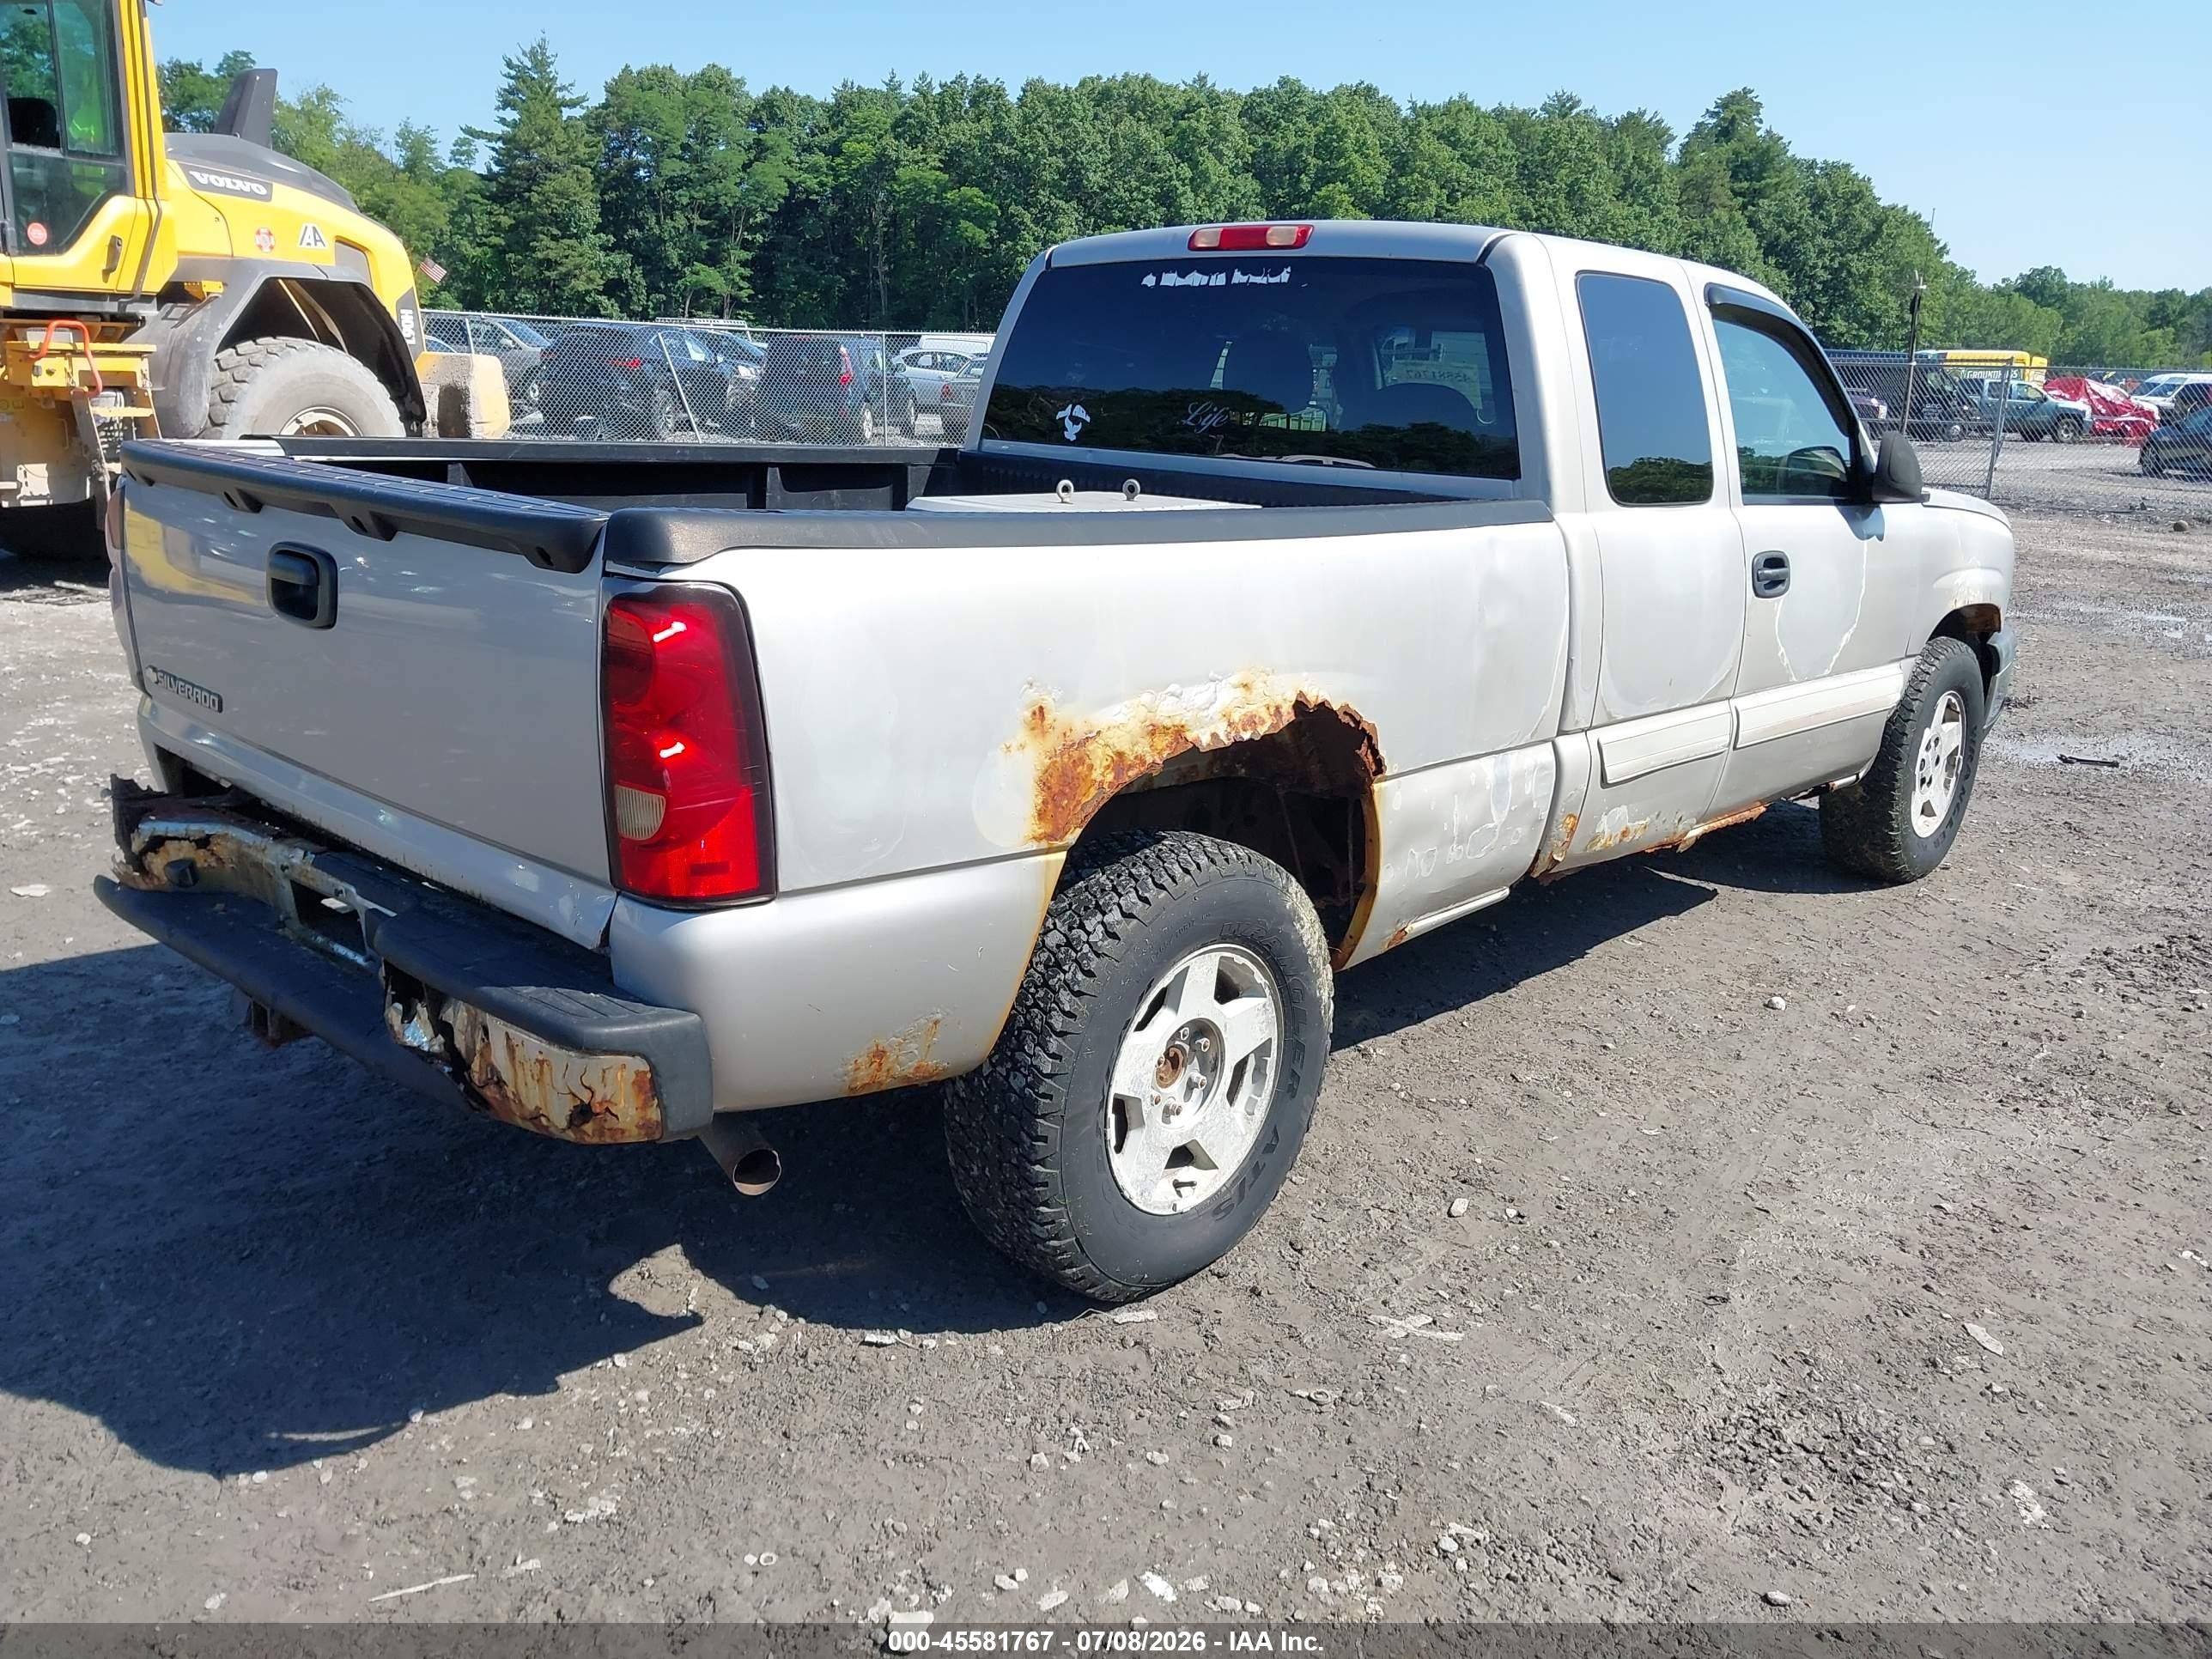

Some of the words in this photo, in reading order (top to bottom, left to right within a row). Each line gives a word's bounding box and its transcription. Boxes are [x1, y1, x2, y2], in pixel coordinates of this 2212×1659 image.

[189, 171, 268, 196] VOLVO
[400, 309, 416, 344] L90H
[157, 671, 220, 711] SILVERADO
